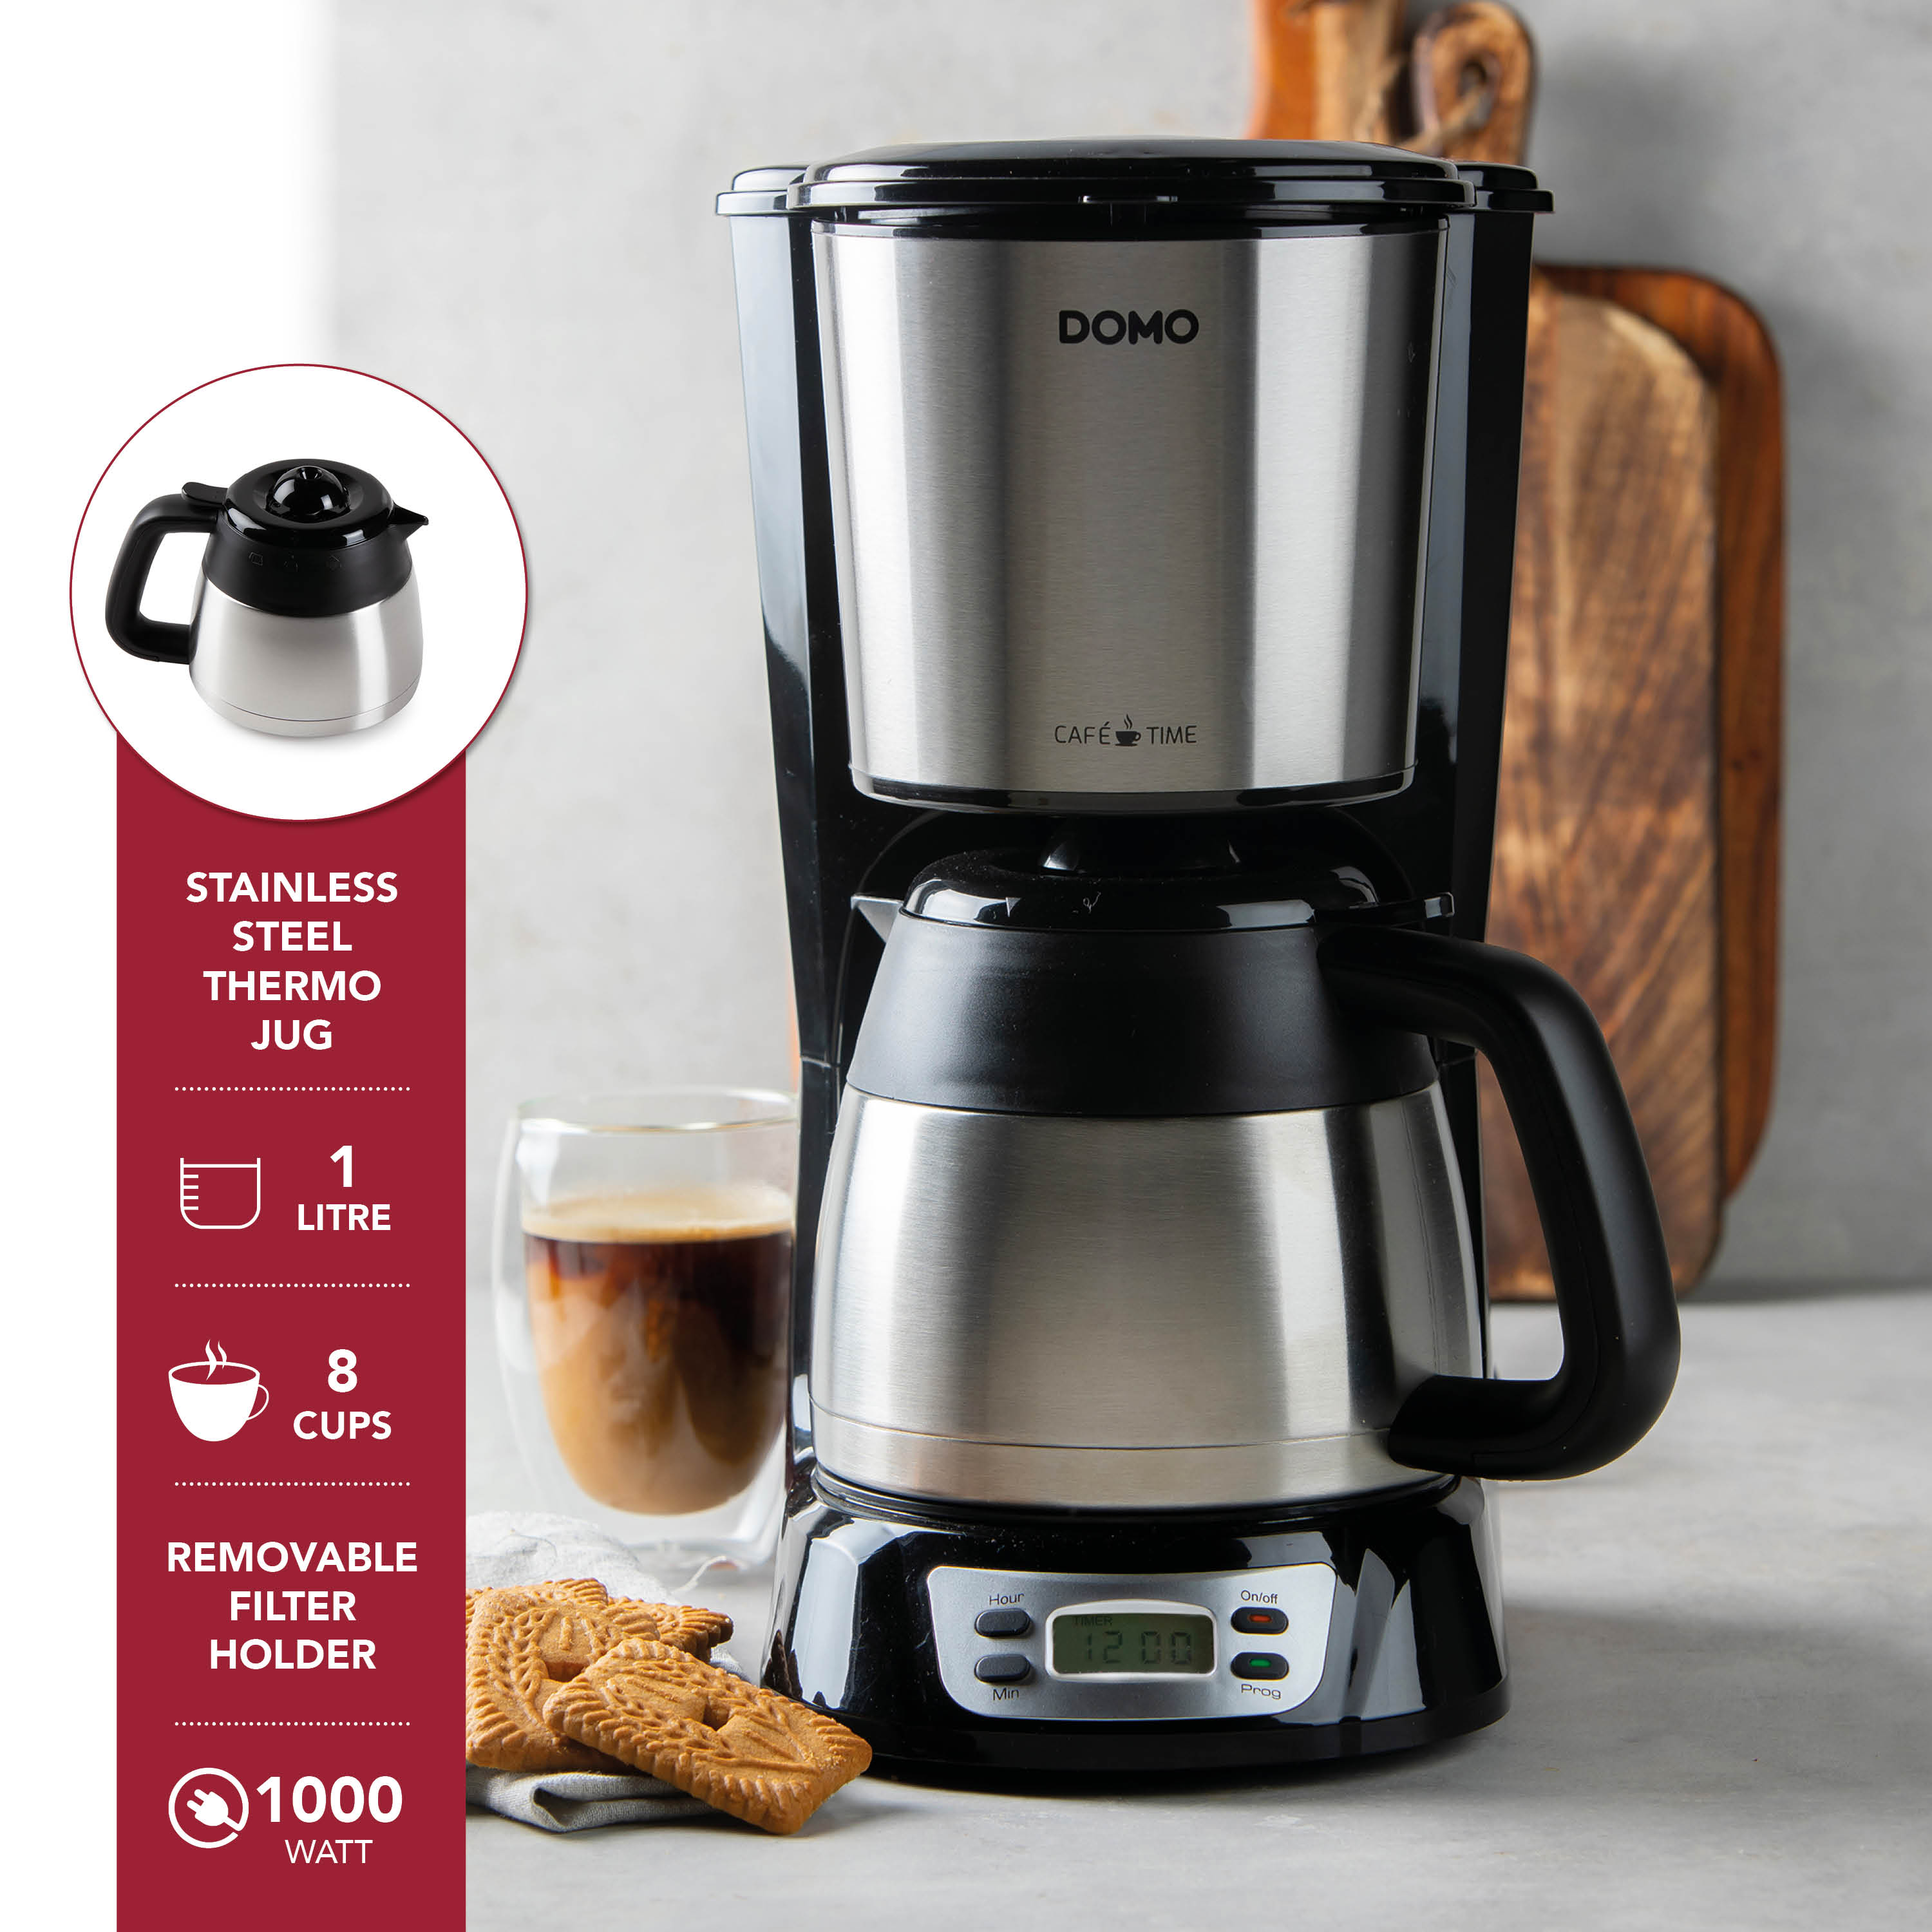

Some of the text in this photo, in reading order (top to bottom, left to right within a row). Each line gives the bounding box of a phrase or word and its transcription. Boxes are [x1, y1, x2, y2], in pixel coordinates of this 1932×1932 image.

[1059, 309, 1199, 345] DOMO
[1054, 721, 1197, 745] CAFÉ TIME
[989, 1592, 1025, 1605] Hour
[1240, 1589, 1278, 1604] On/off
[1074, 1615, 1113, 1627] TIMER
[992, 1686, 1019, 1701] Min
[1241, 1683, 1282, 1700] Prog
